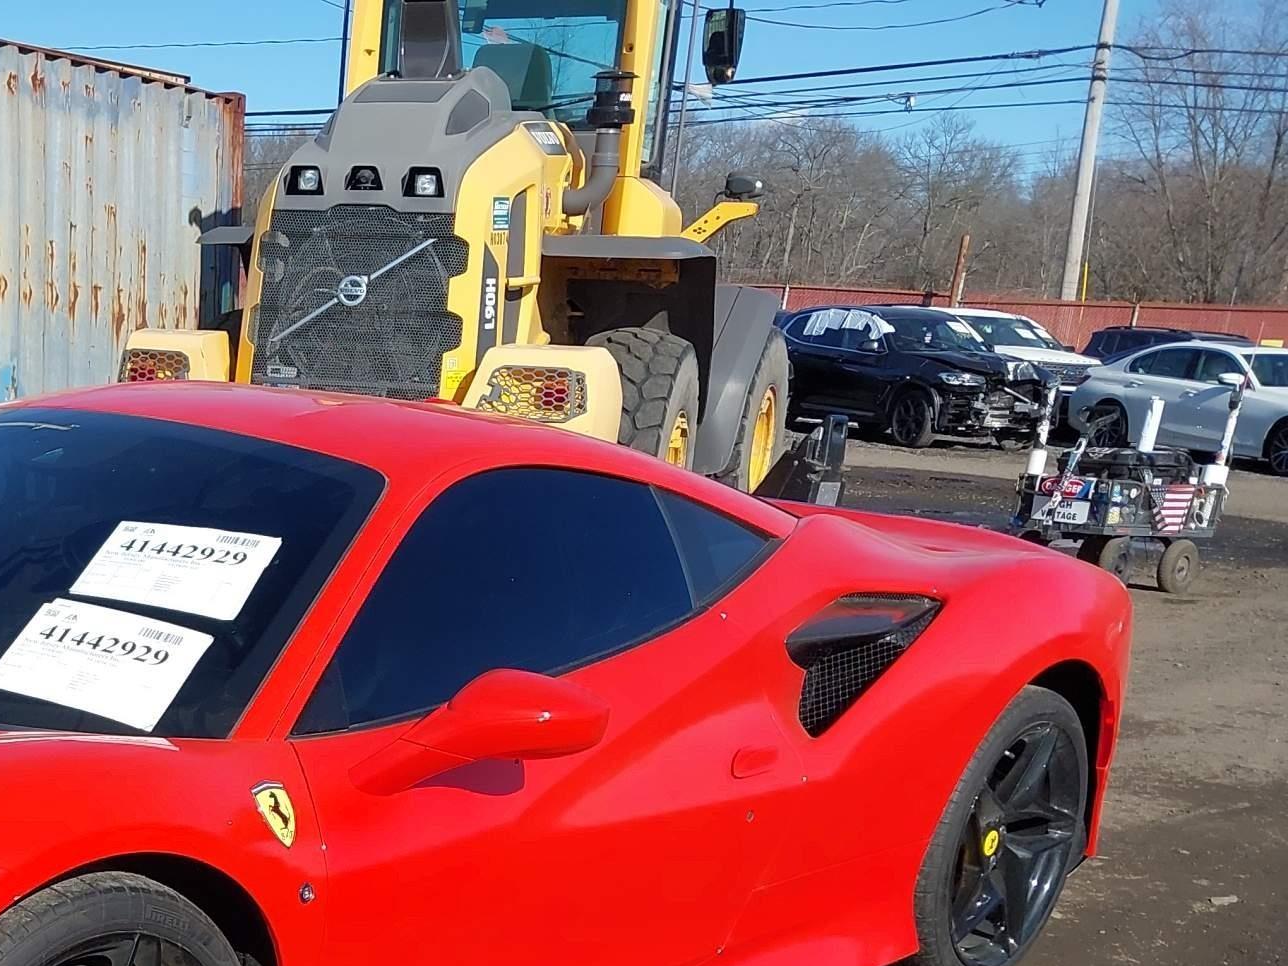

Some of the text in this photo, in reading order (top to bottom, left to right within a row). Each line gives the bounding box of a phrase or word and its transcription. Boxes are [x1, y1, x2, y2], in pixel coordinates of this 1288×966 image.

[484, 277, 497, 330] L90H
[1041, 510, 1077, 521] VTAGE
[120, 538, 248, 566] 41442929
[39, 624, 170, 666] 41442929
